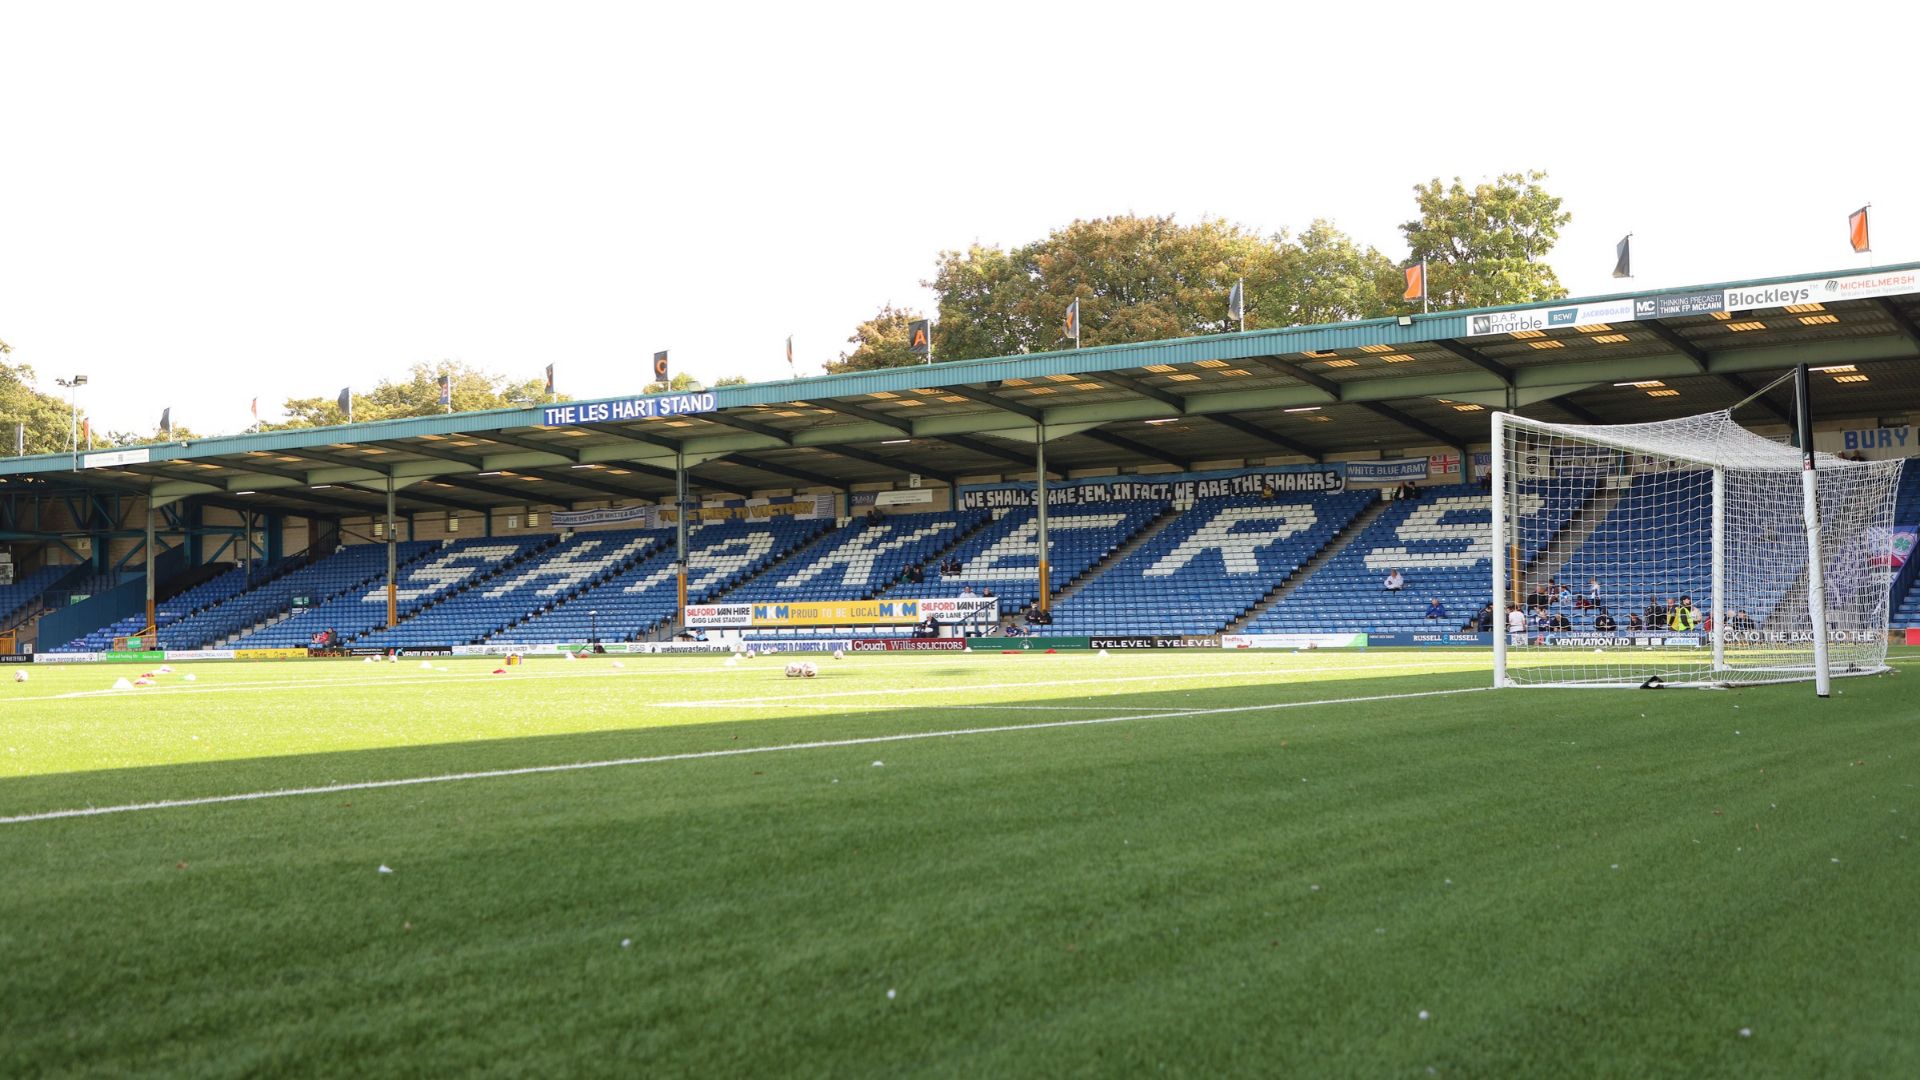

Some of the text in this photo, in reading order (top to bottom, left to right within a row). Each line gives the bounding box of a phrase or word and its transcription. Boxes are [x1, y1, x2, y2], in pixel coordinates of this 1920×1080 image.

[1840, 275, 1915, 290] MICHELMERSH
[1659, 294, 1722, 306] THINKING PRECAST?
[1728, 288, 1810, 307] Blockleys
[1660, 304, 1681, 314] THINK
[1491, 316, 1542, 333] marble
[914, 330, 927, 347] A
[545, 393, 714, 425] THE LES HART STAND
[1844, 425, 1911, 450] BURY
[1347, 465, 1375, 475] WHITE
[1376, 464, 1399, 475] BLUE
[1400, 462, 1427, 474] ARMY
[964, 491, 984, 508] WE
[986, 489, 1029, 507] SHALL
[1031, 487, 1076, 506] SAKE
[1112, 483, 1131, 500] IN
[1174, 482, 1195, 500] WE
[1198, 479, 1231, 498] ARE
[1231, 474, 1263, 494] THE
[658, 506, 732, 522] TOETHER
[750, 500, 816, 518] VICTORY
[686, 606, 751, 617] SALFORD VAN HIRE
[754, 605, 790, 619] MKM
[791, 606, 878, 618] PROUD TO BE LOCAL
[879, 602, 917, 617] MKM
[921, 602, 956, 611] SALFORD
[956, 601, 974, 611] VAN
[707, 616, 722, 624] LANE
[853, 639, 963, 651] Clough Willis SOLICITORS
[1091, 640, 1150, 648] EYELEVEL
[1157, 639, 1217, 647] EYELEVEL
[1555, 638, 1612, 646] VENTILATION
[1614, 637, 1630, 646] LTD
